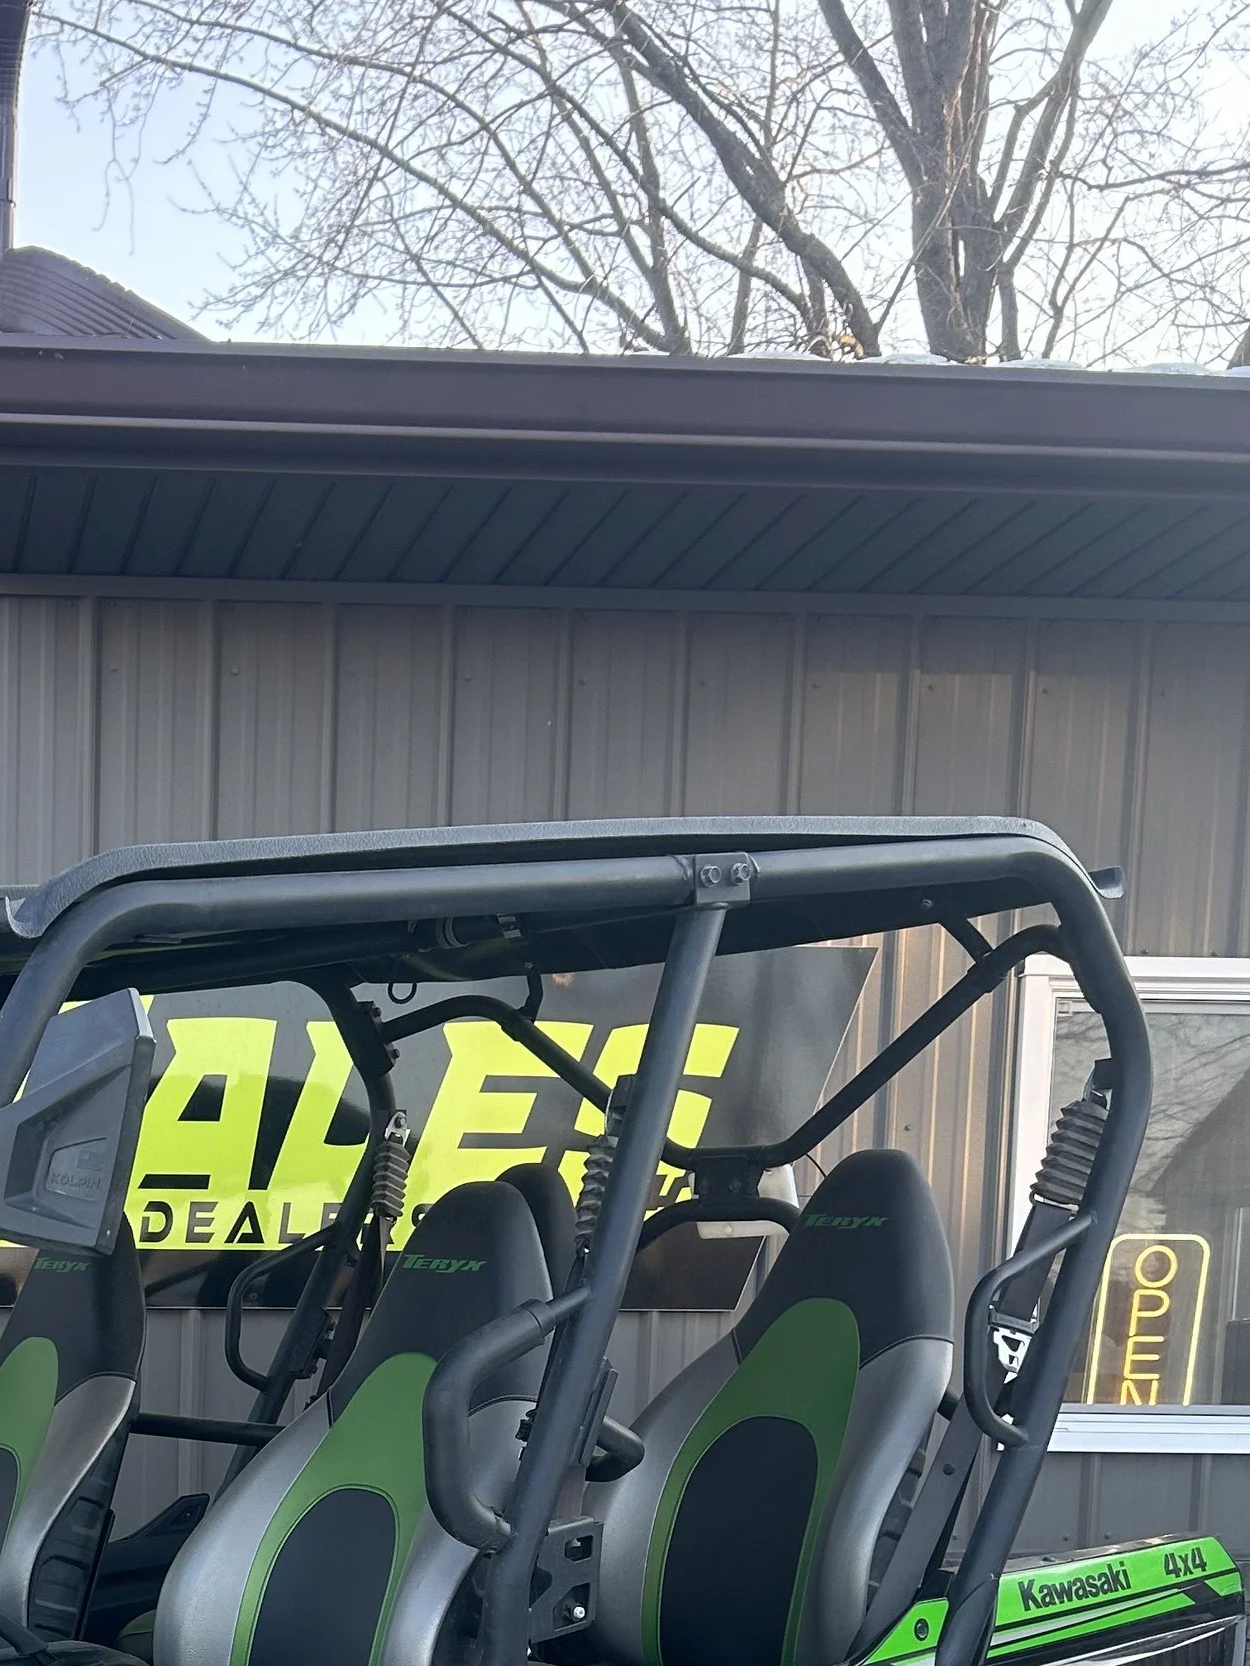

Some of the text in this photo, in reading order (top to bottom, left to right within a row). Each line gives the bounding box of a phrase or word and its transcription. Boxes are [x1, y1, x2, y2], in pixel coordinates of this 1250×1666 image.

[128, 1016, 739, 1202] ALES
[403, 1254, 487, 1273] TERYX
[1017, 1547, 1208, 1612] Kawasaki 4x4
